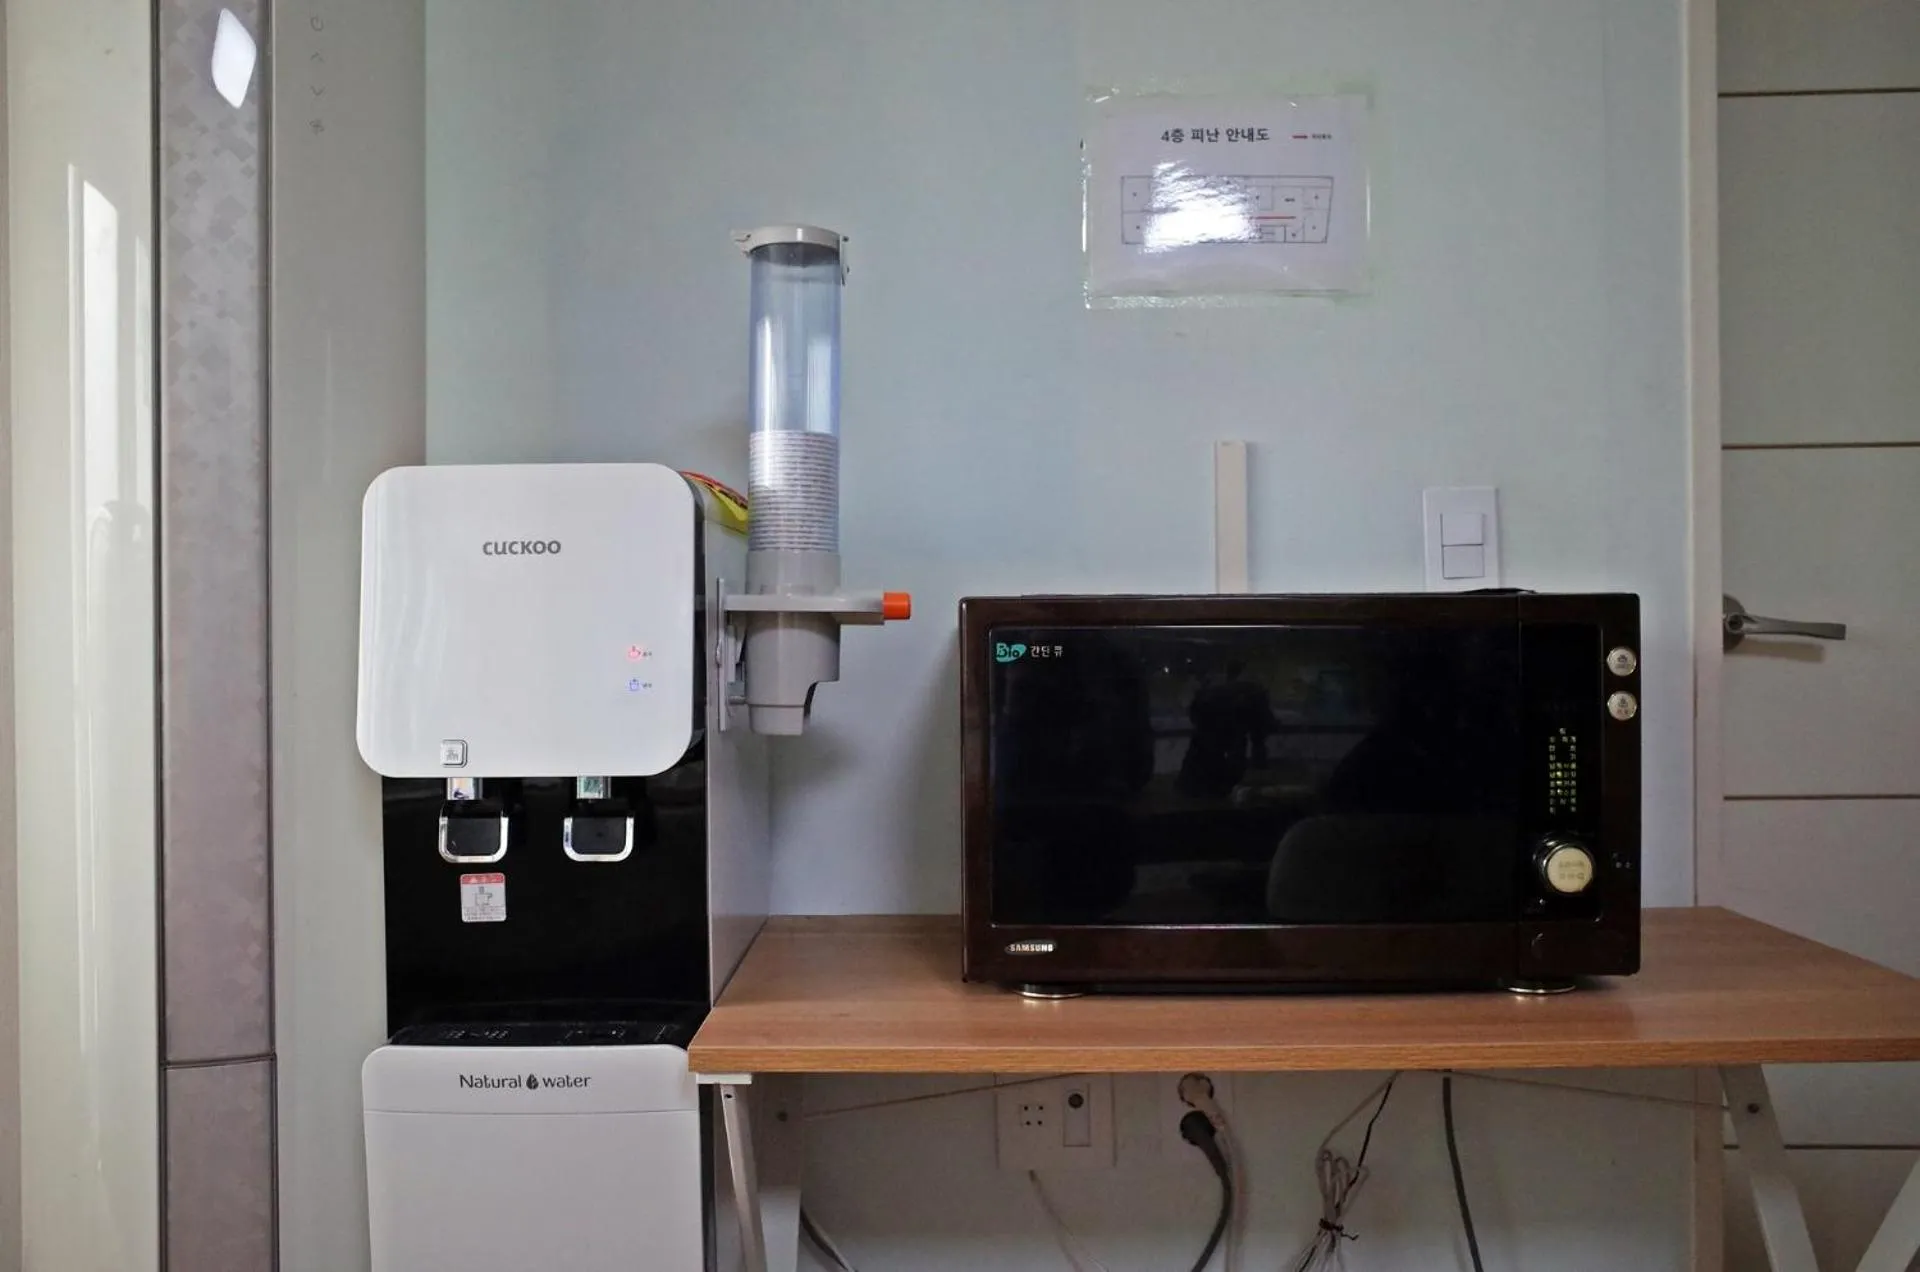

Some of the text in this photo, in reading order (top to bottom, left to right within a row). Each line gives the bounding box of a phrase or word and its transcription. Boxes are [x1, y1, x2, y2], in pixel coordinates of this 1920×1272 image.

[1161, 128, 1270, 143] 4층 피난 안내도
[1010, 943, 1054, 952] SAMSUNG
[459, 1074, 591, 1089] Natural water
